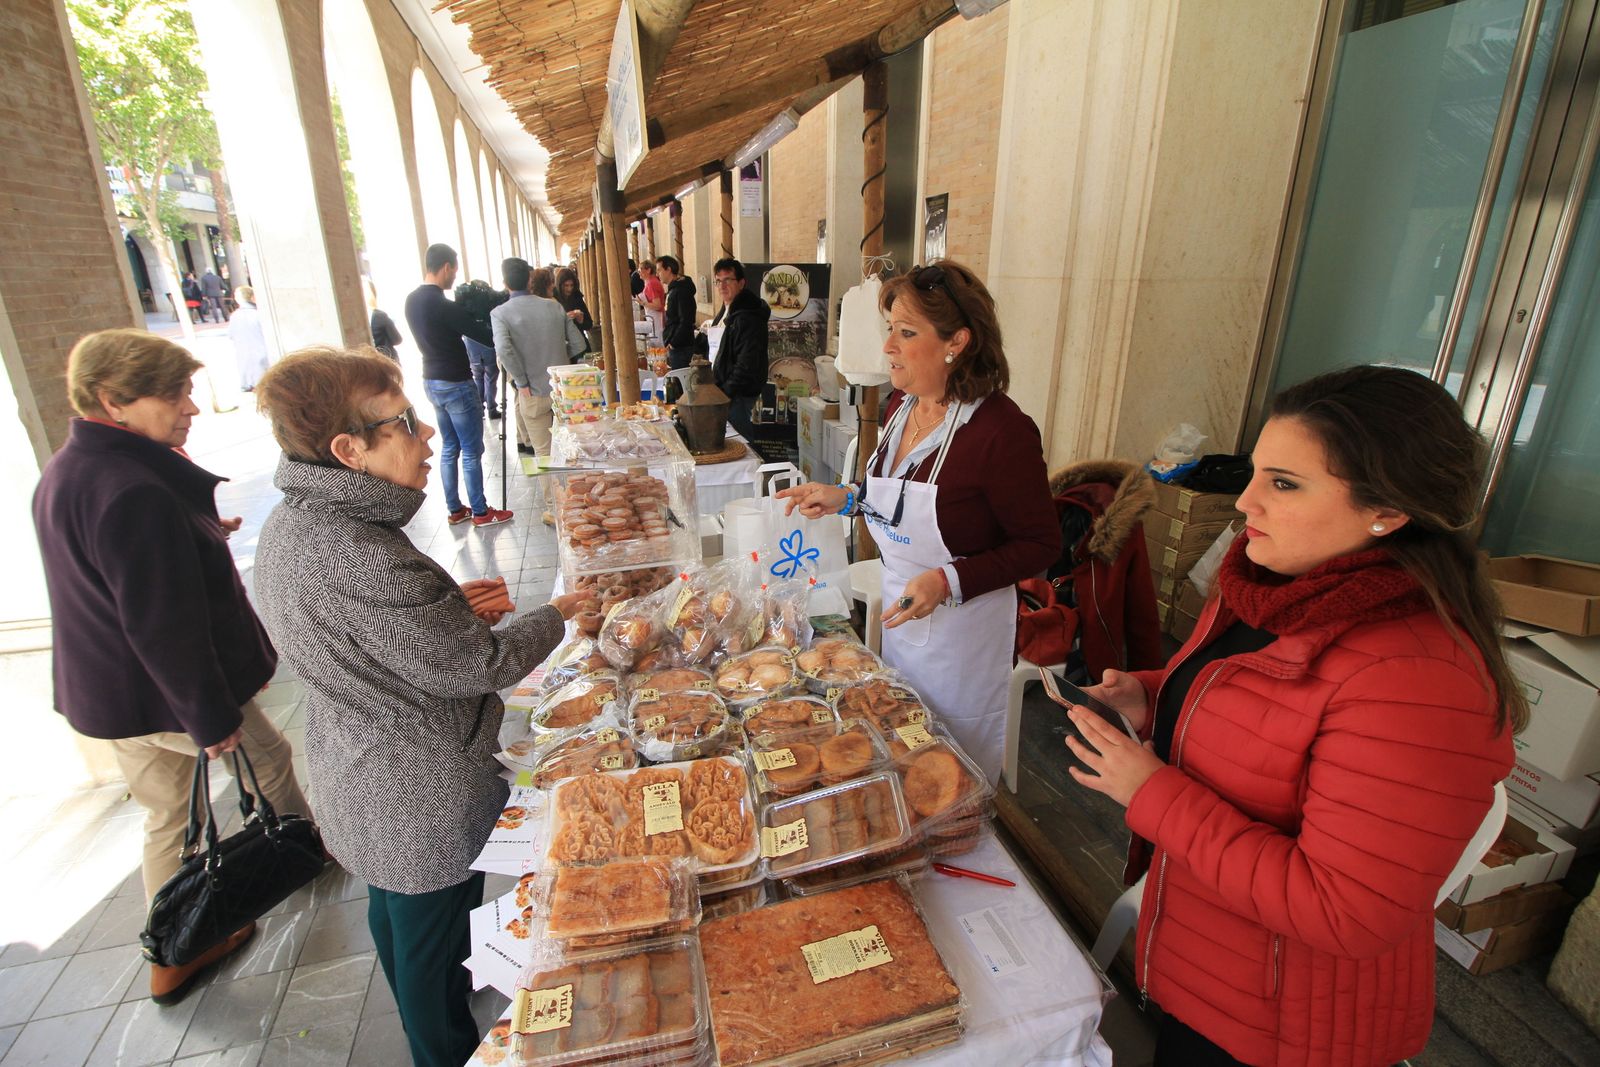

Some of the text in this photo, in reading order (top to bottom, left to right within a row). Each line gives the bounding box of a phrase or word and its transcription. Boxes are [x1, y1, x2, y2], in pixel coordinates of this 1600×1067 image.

[762, 271, 810, 285] CANDÓN
[648, 783, 674, 791] VILLA
[1511, 774, 1537, 793] FRITAS
[797, 822, 805, 845] VILLA
[875, 933, 888, 955] VILLA
[560, 990, 569, 1022] VILLA
